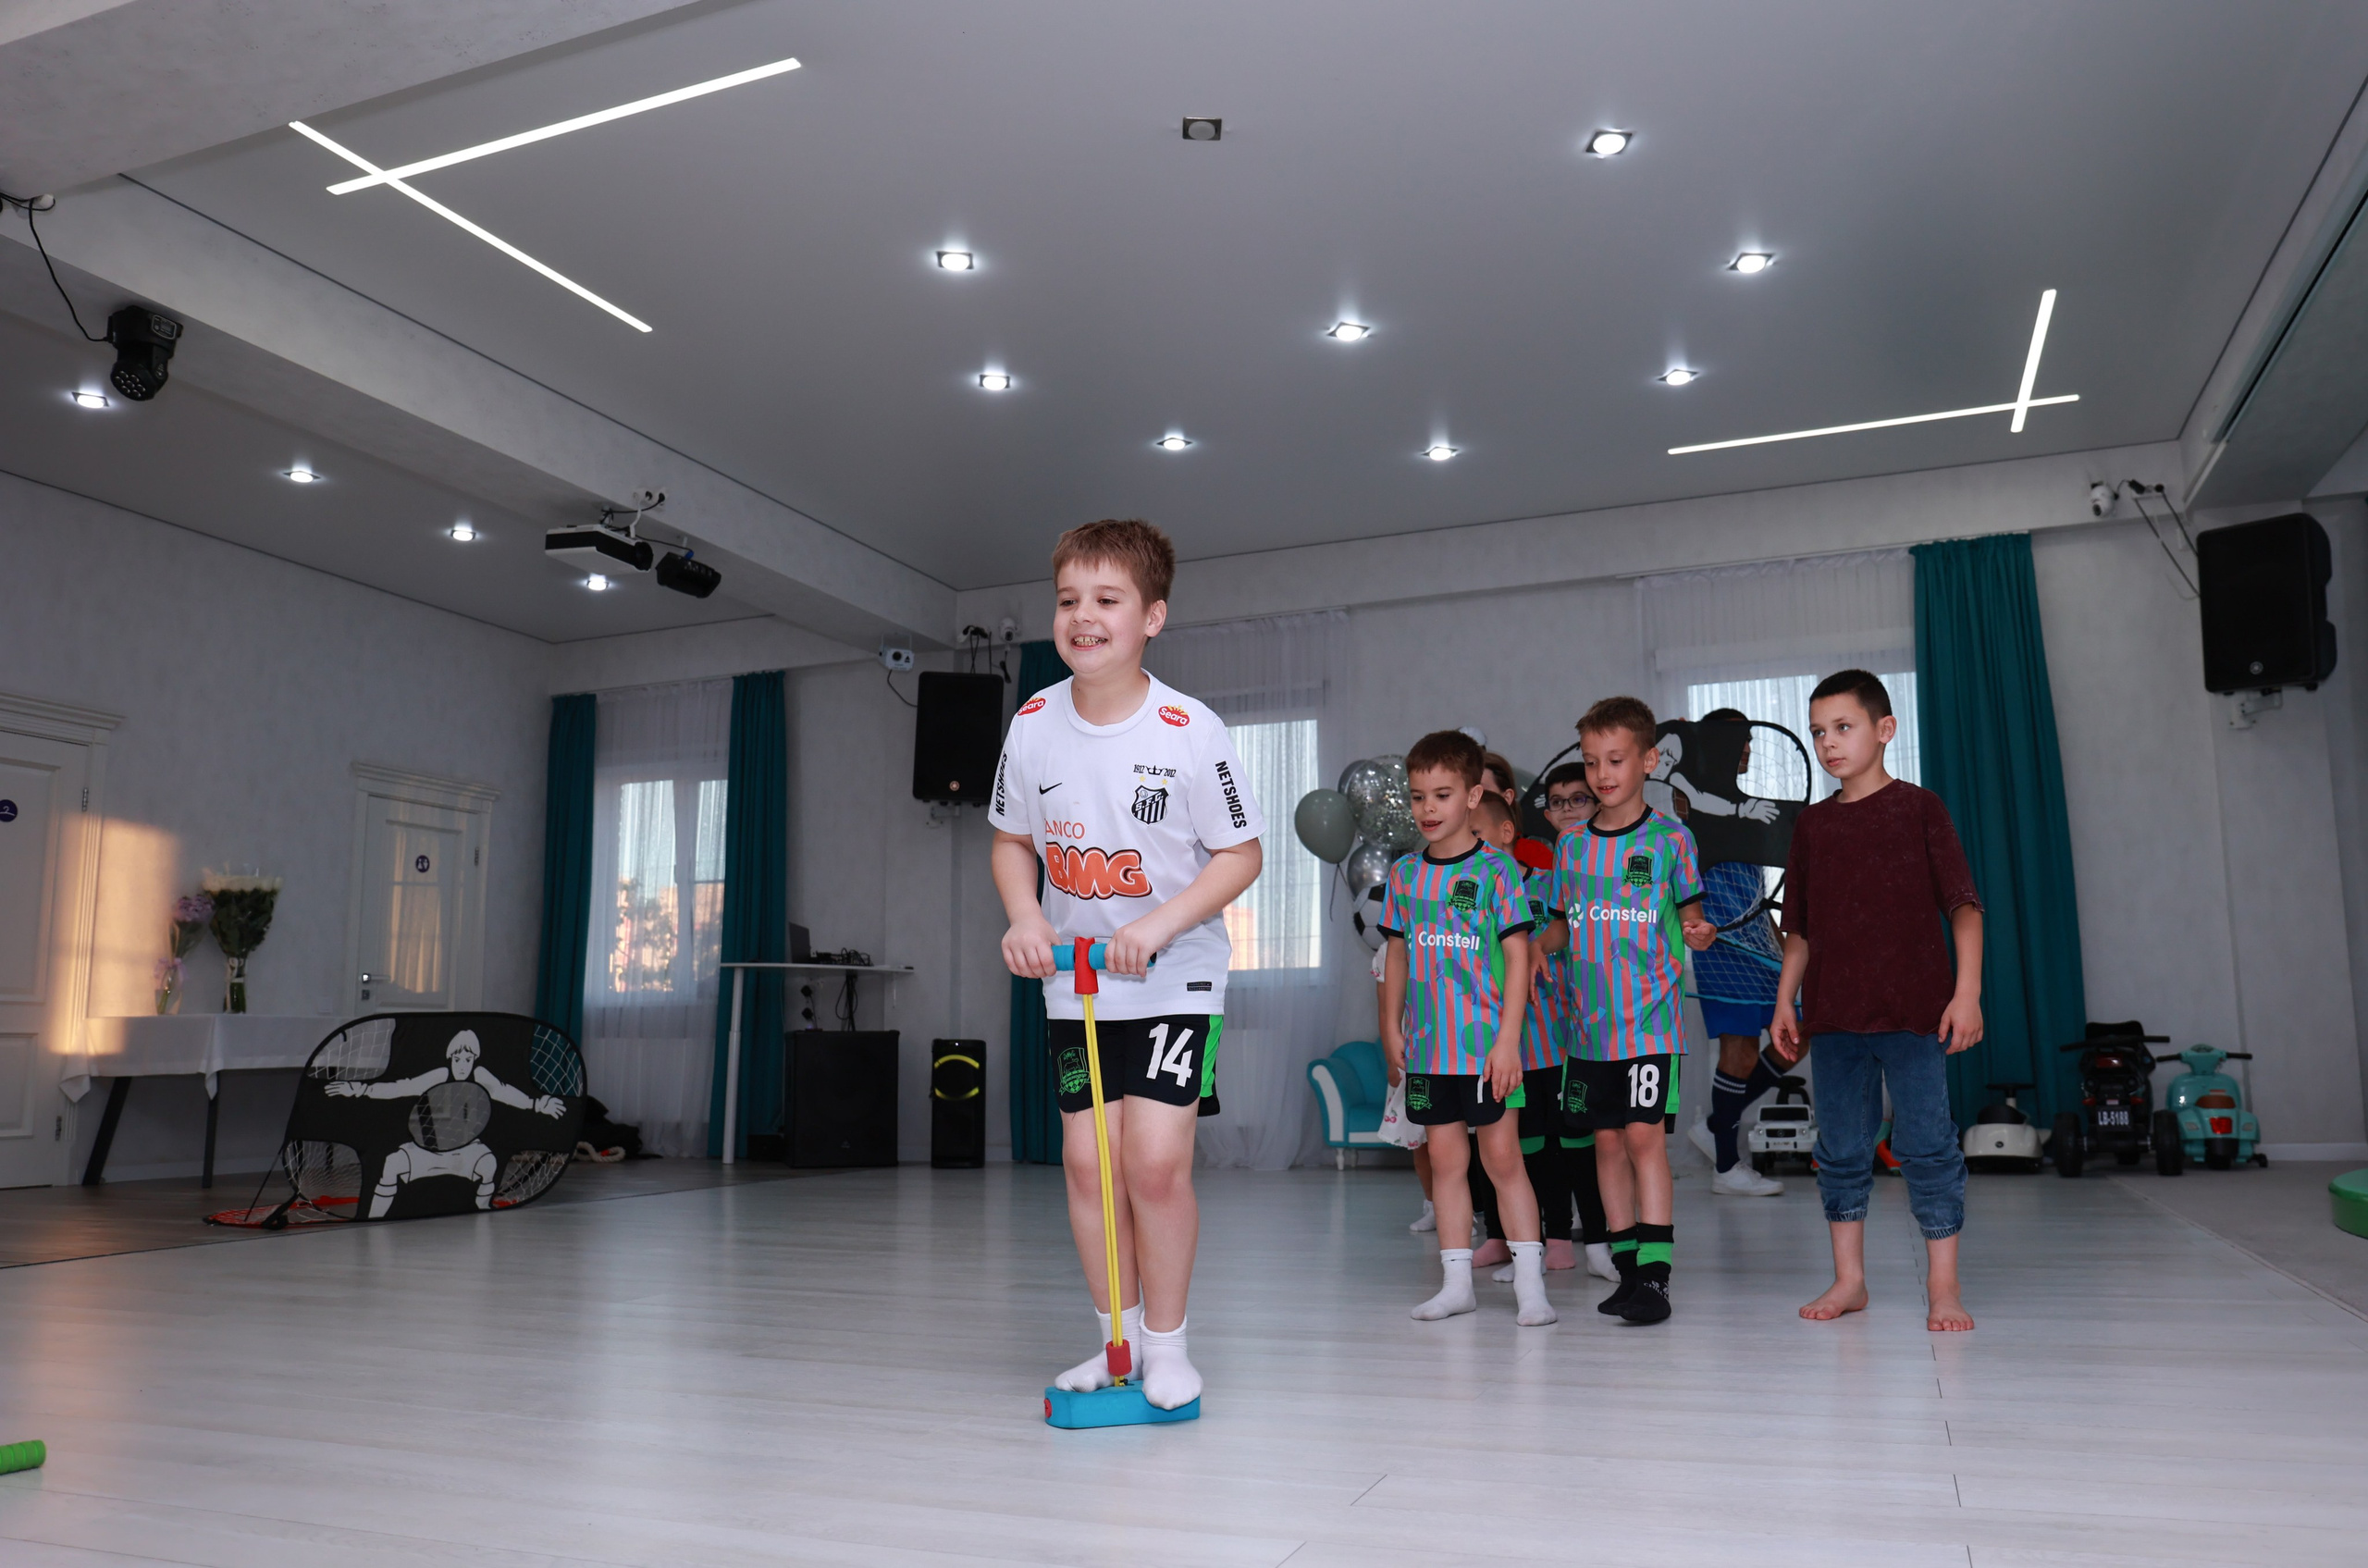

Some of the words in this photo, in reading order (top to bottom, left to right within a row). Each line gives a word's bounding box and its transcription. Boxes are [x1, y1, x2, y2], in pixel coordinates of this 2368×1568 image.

[1159, 707, 1188, 725] Seara
[1133, 764, 1145, 774] 1912
[1215, 760, 1247, 829] NETSHOES
[1044, 818, 1085, 840] ANCO
[1045, 841, 1153, 900] BMG
[1589, 905, 1658, 924] Constell
[1418, 931, 1480, 951] Constell
[1146, 1022, 1194, 1088] 14
[1627, 1064, 1659, 1108] 18
